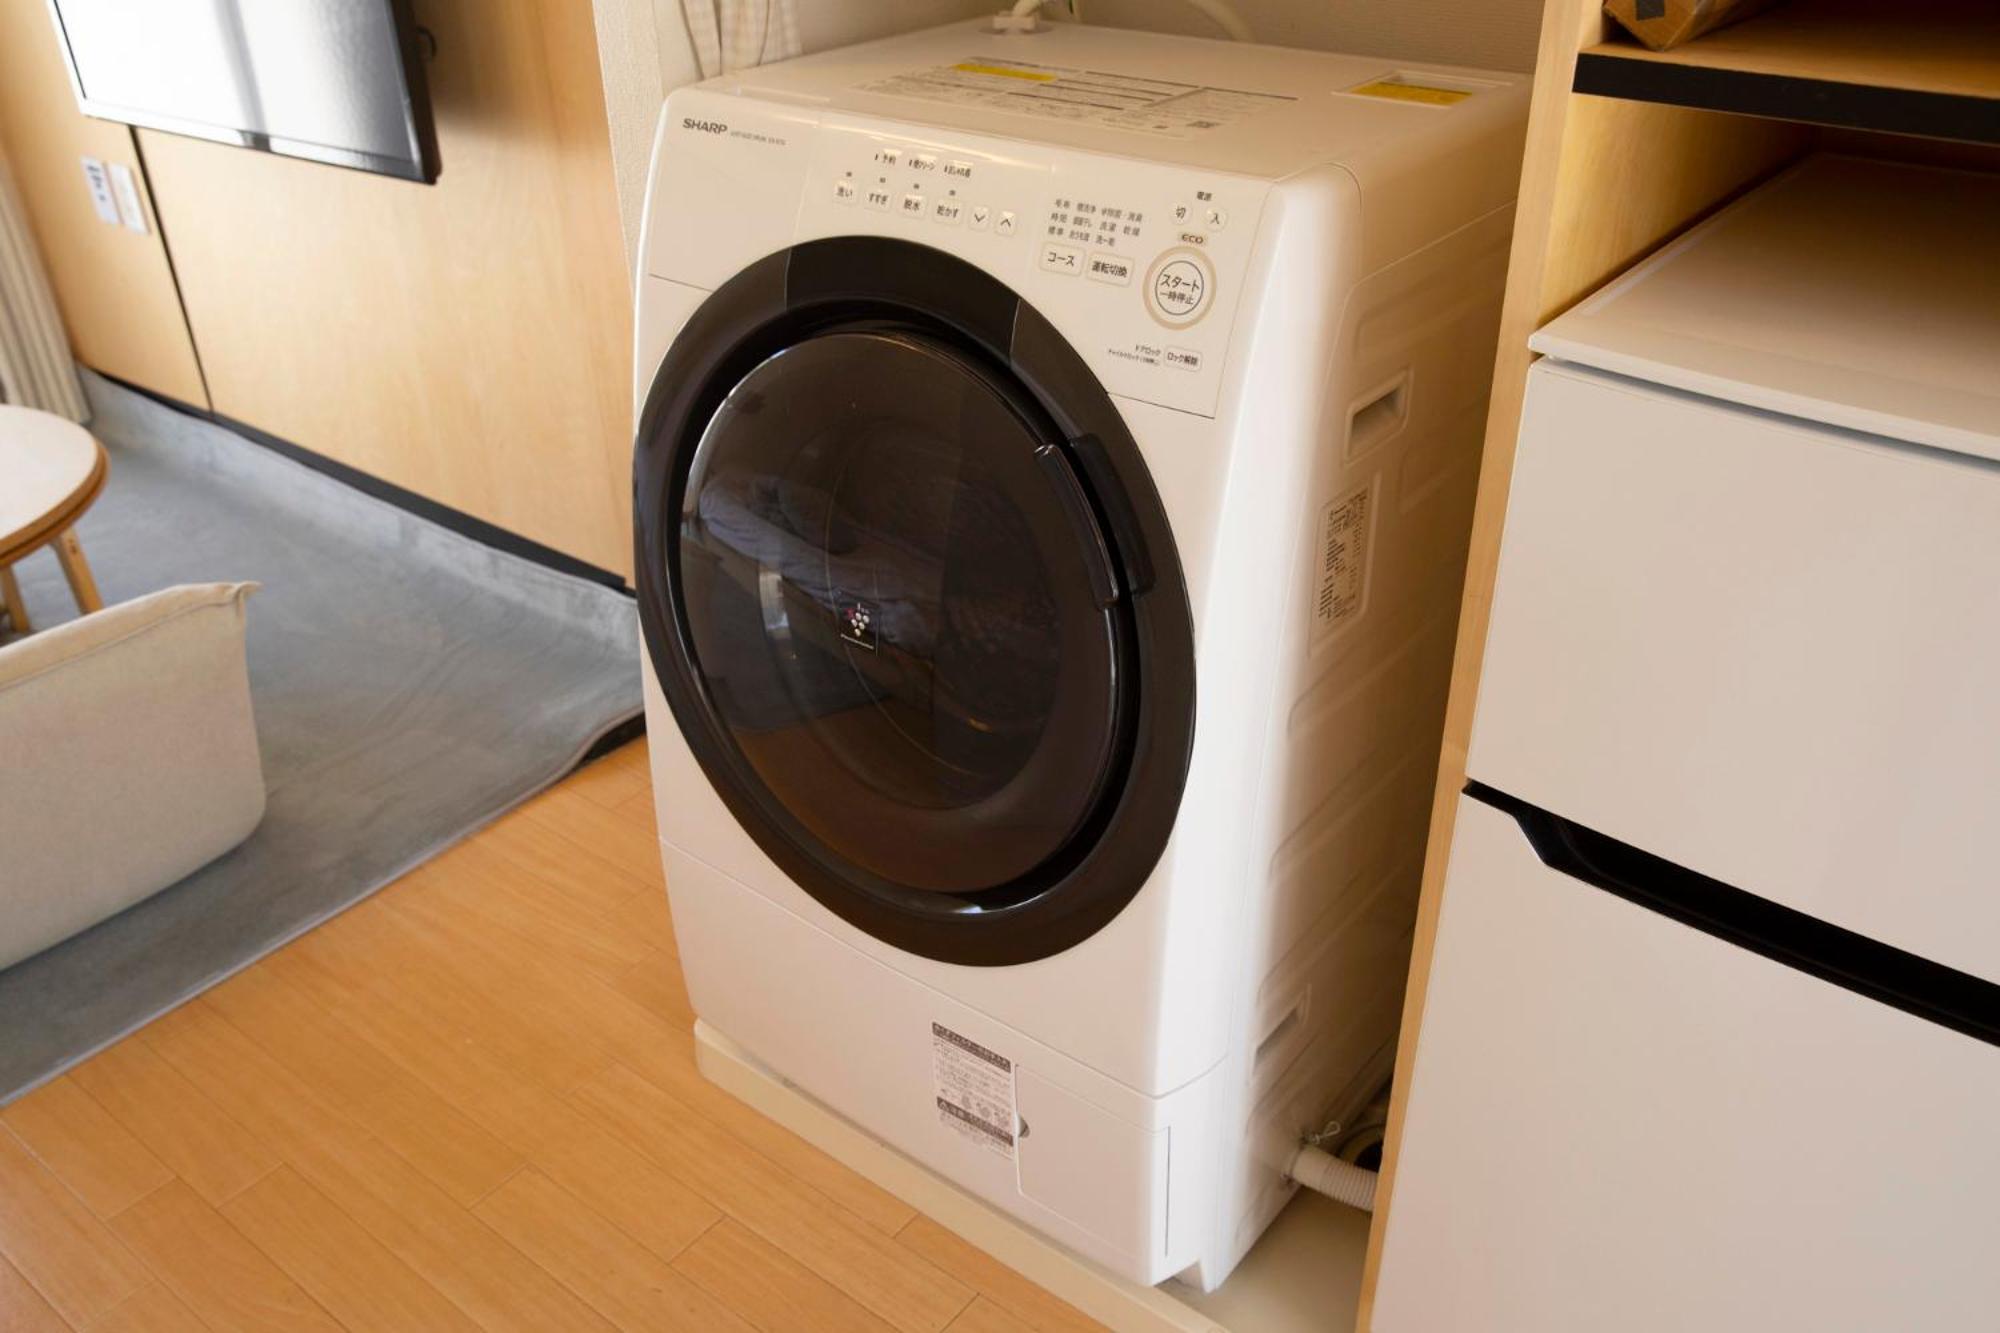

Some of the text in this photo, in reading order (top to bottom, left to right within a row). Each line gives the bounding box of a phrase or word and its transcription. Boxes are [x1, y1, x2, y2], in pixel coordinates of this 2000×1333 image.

[683, 118, 728, 134] SHARP
[904, 199, 920, 211] 脱水
[937, 205, 958, 218] 乾かす
[1176, 206, 1186, 219] 切
[1211, 213, 1219, 224] 入
[1048, 252, 1074, 266] コース
[1092, 261, 1127, 277] 運転切換
[1160, 273, 1200, 292] スタート
[1160, 292, 1194, 305] 一時停止
[1167, 352, 1198, 365] ロック解除
